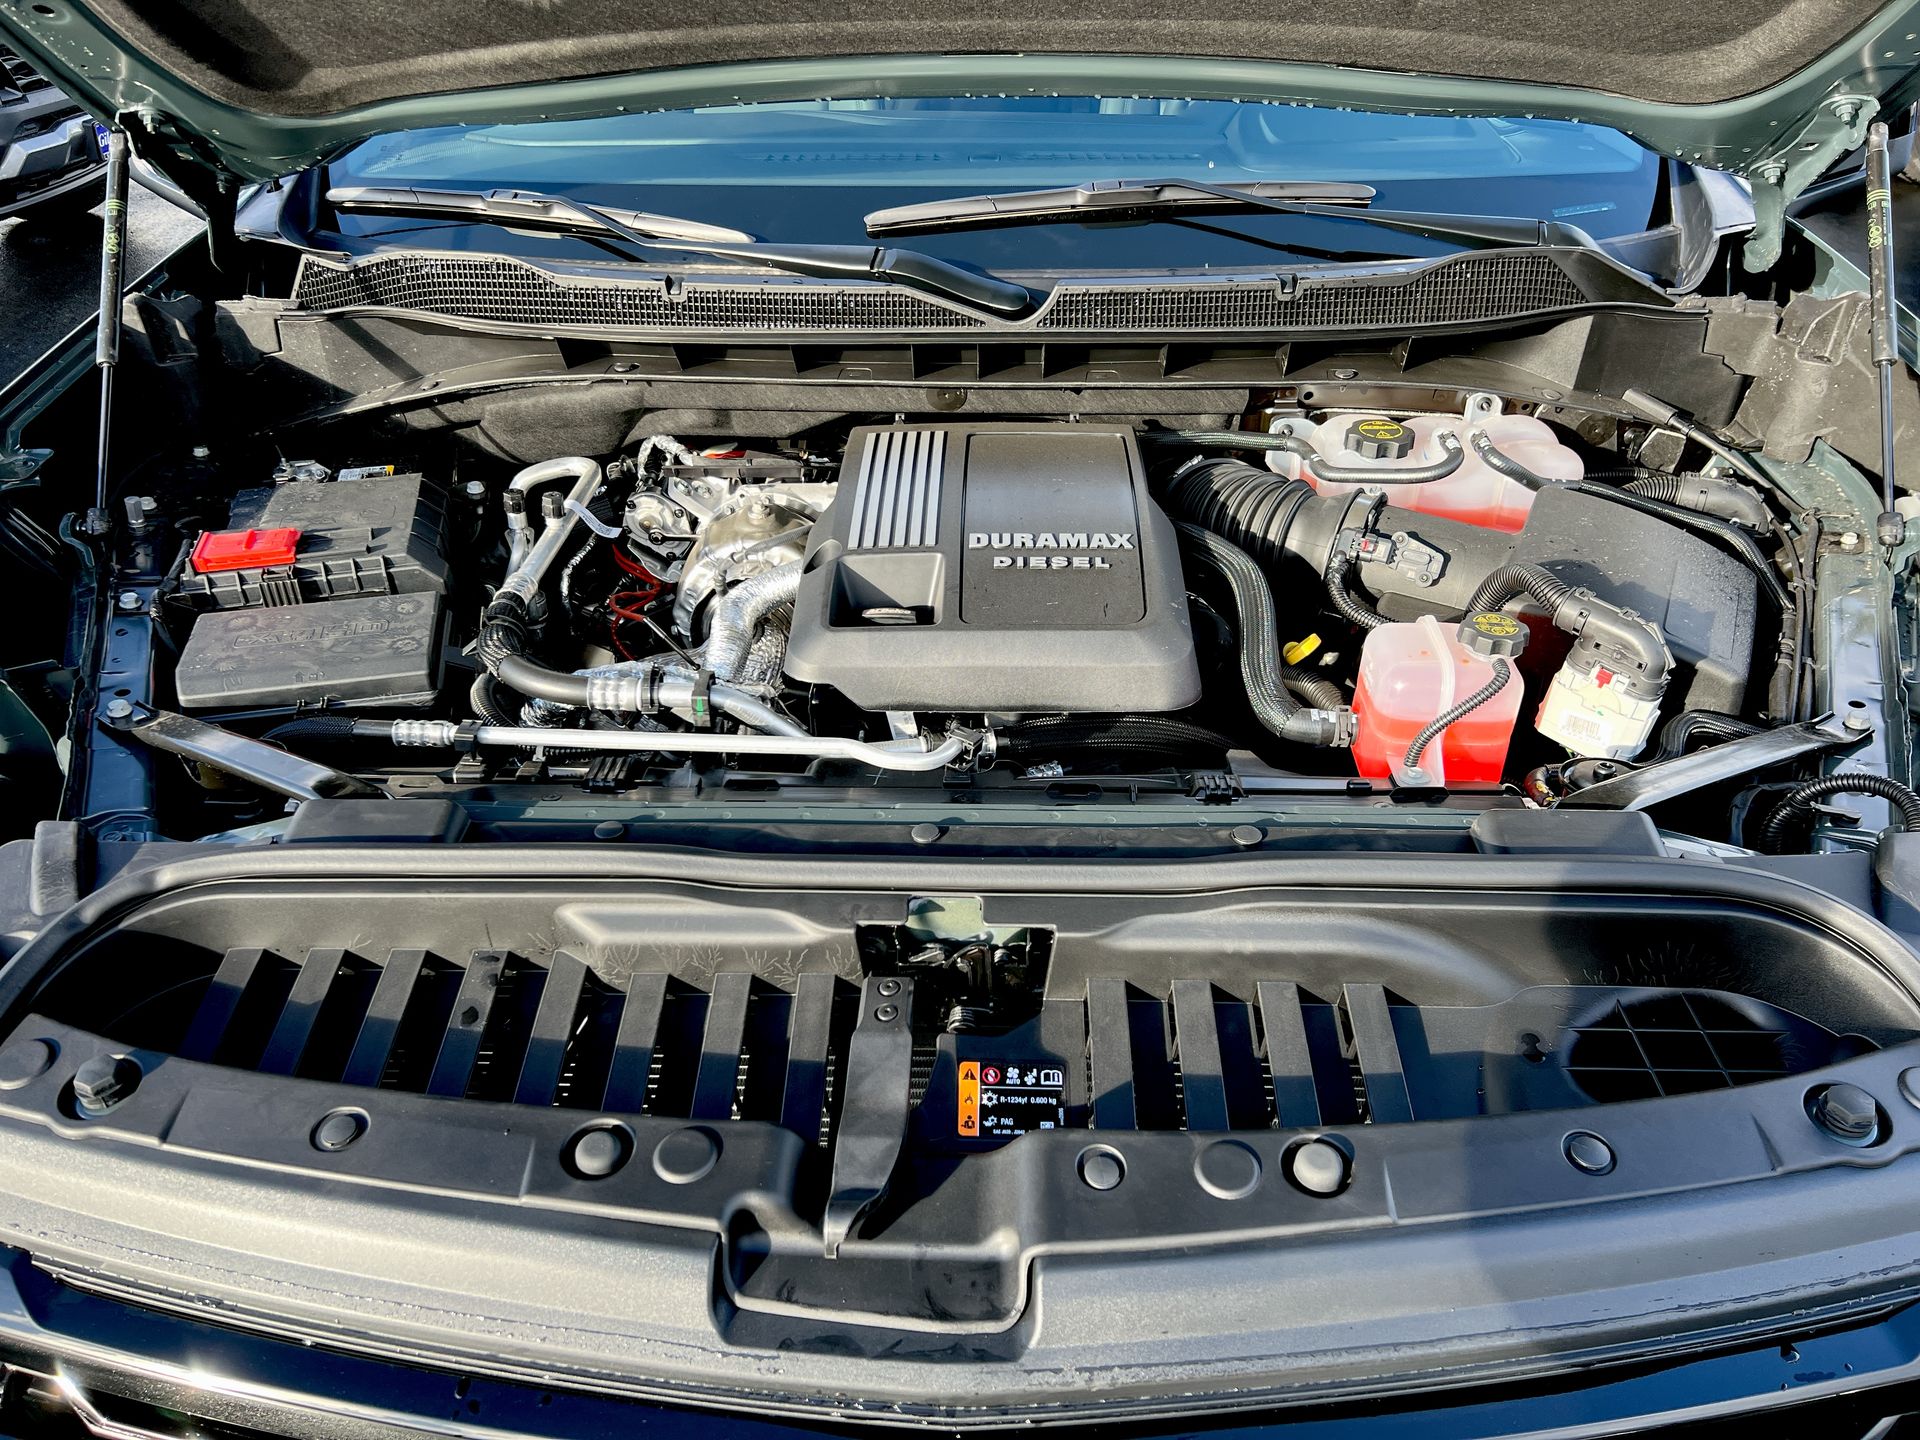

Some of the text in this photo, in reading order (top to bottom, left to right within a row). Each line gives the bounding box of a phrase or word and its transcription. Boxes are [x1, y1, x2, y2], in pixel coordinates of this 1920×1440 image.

[968, 533, 1135, 549] DURAMAX
[993, 556, 1110, 569] DIESEL
[1000, 1096, 1028, 1105] R-1234yf
[1049, 1096, 1057, 1105] kg
[1000, 1118, 1014, 1126] PAG
